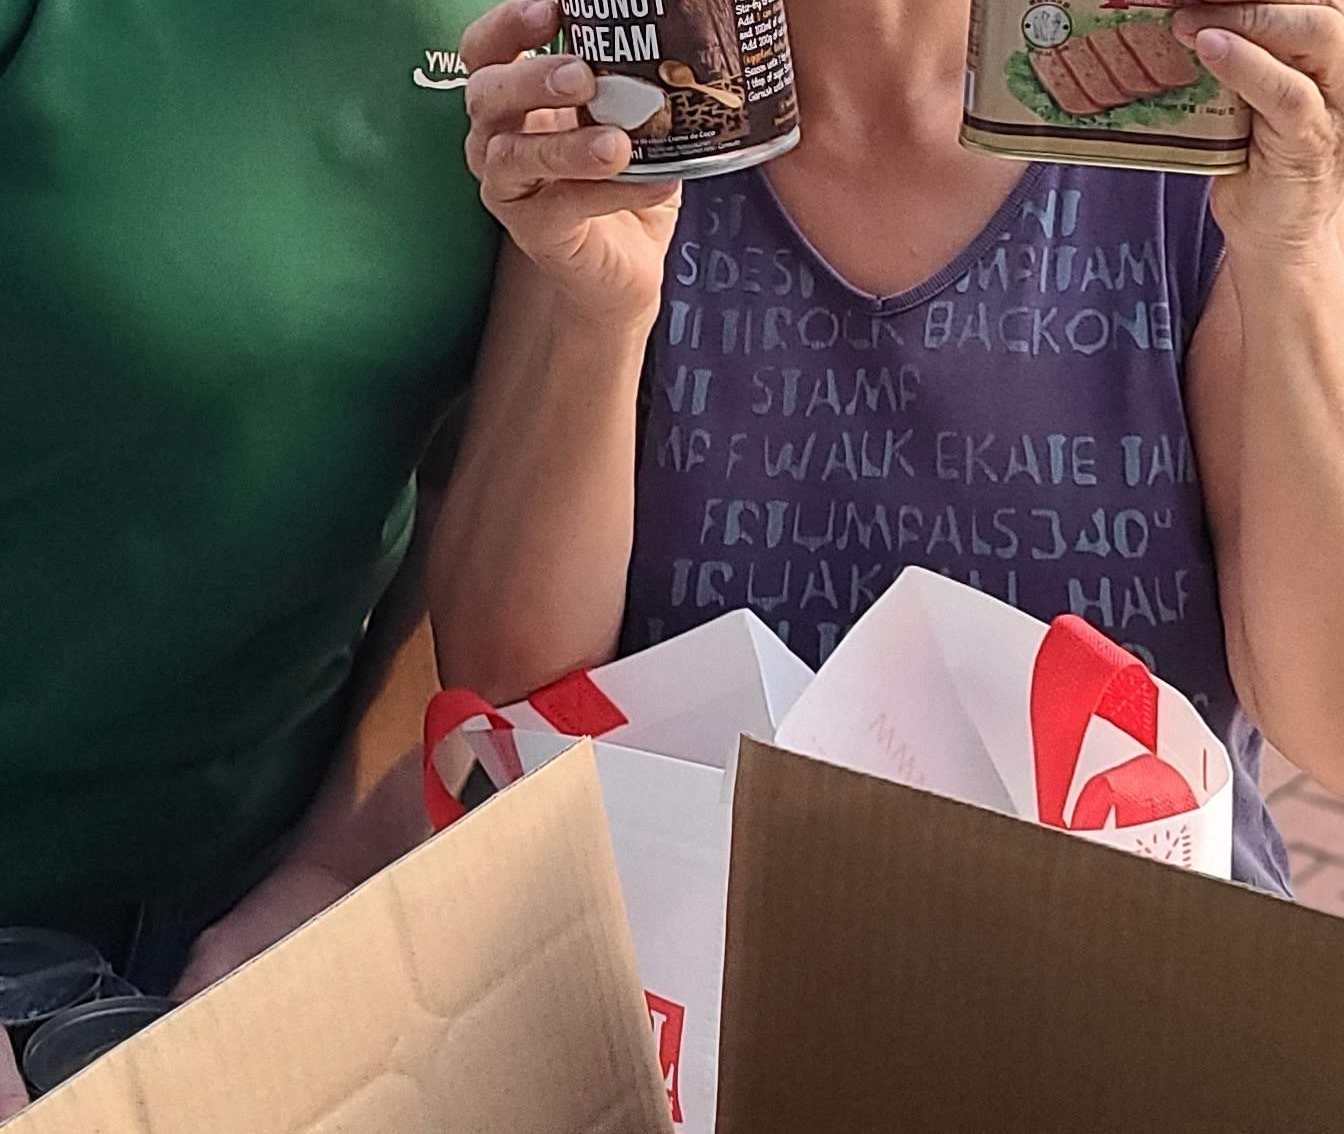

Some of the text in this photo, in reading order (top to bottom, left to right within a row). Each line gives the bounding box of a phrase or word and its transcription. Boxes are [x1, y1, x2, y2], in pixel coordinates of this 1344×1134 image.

[571, 24, 660, 62] CREAM
[425, 50, 469, 75] YWA
[764, 429, 915, 481] WALK
